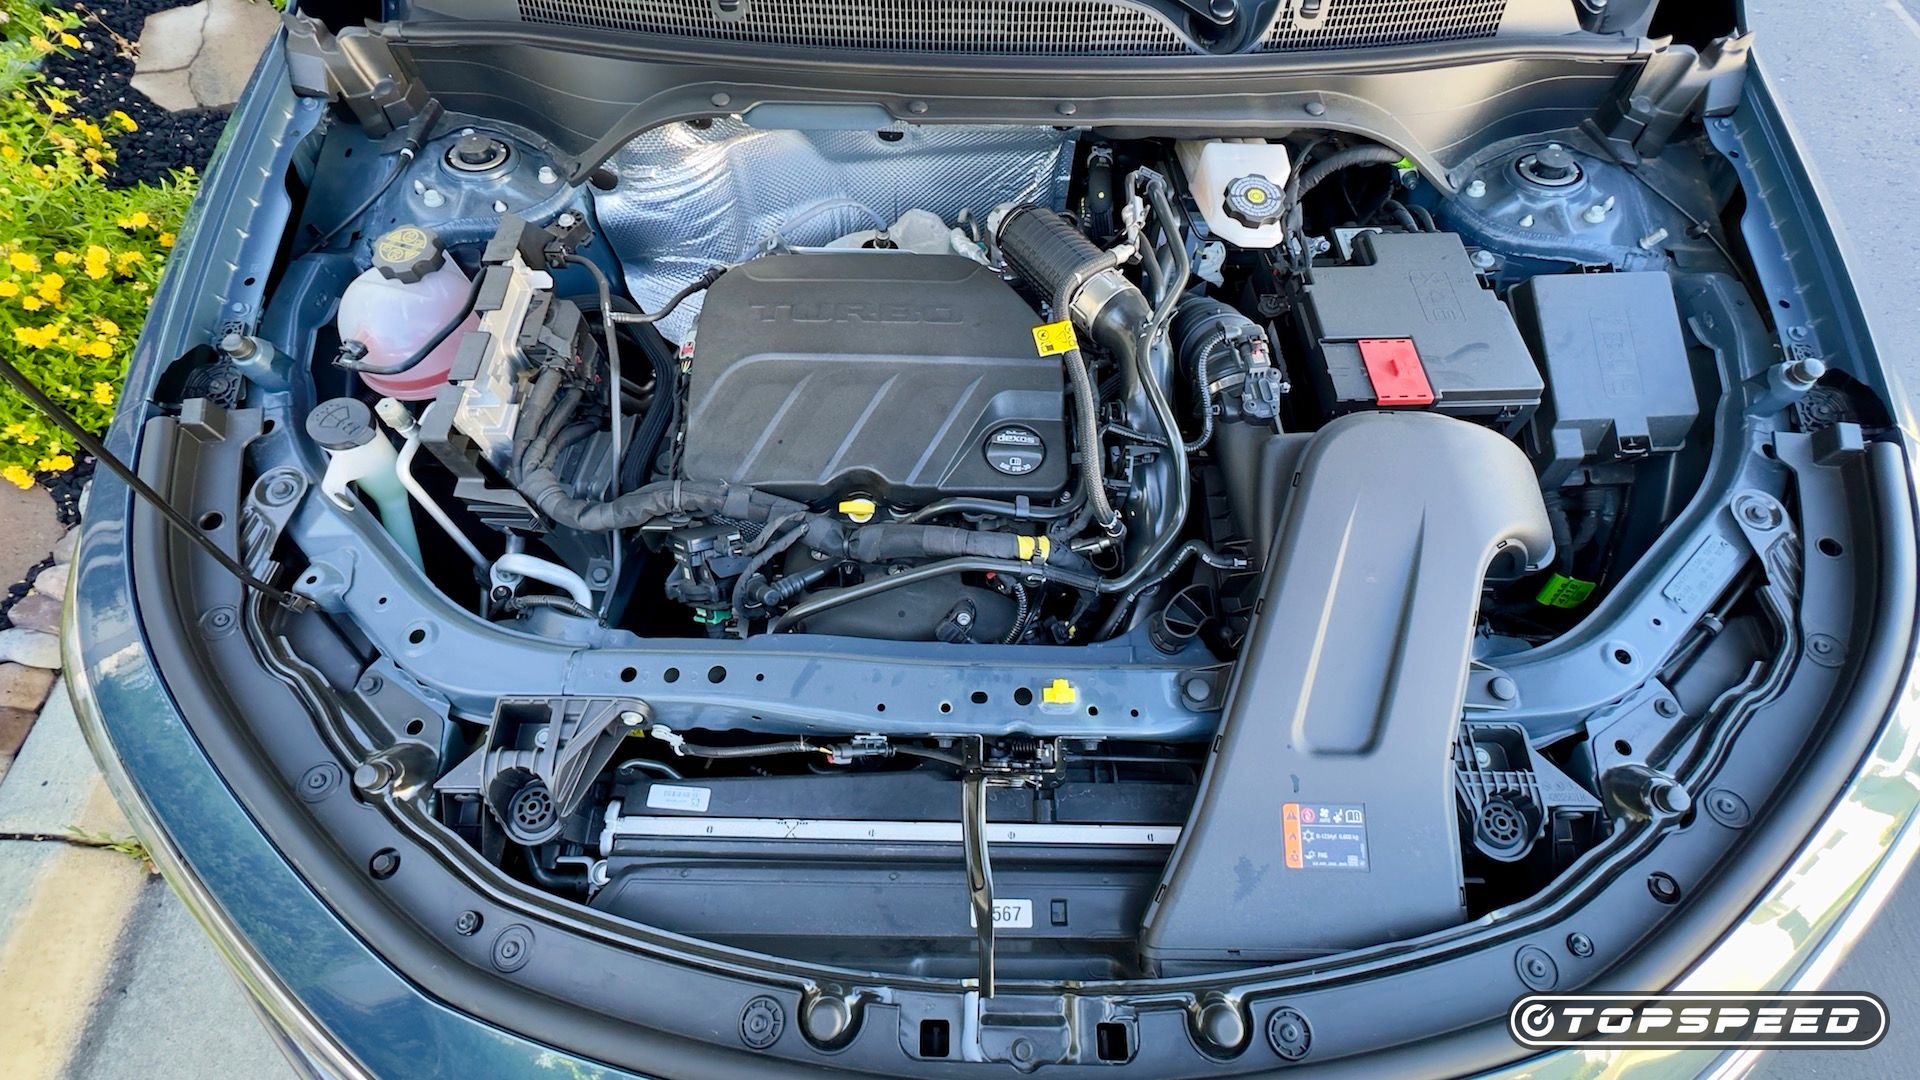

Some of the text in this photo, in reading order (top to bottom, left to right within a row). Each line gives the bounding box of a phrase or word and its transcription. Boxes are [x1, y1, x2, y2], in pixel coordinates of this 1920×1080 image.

[751, 303, 964, 325] TURBO
[997, 433, 1035, 443] dexos
[992, 905, 1022, 922] 567
